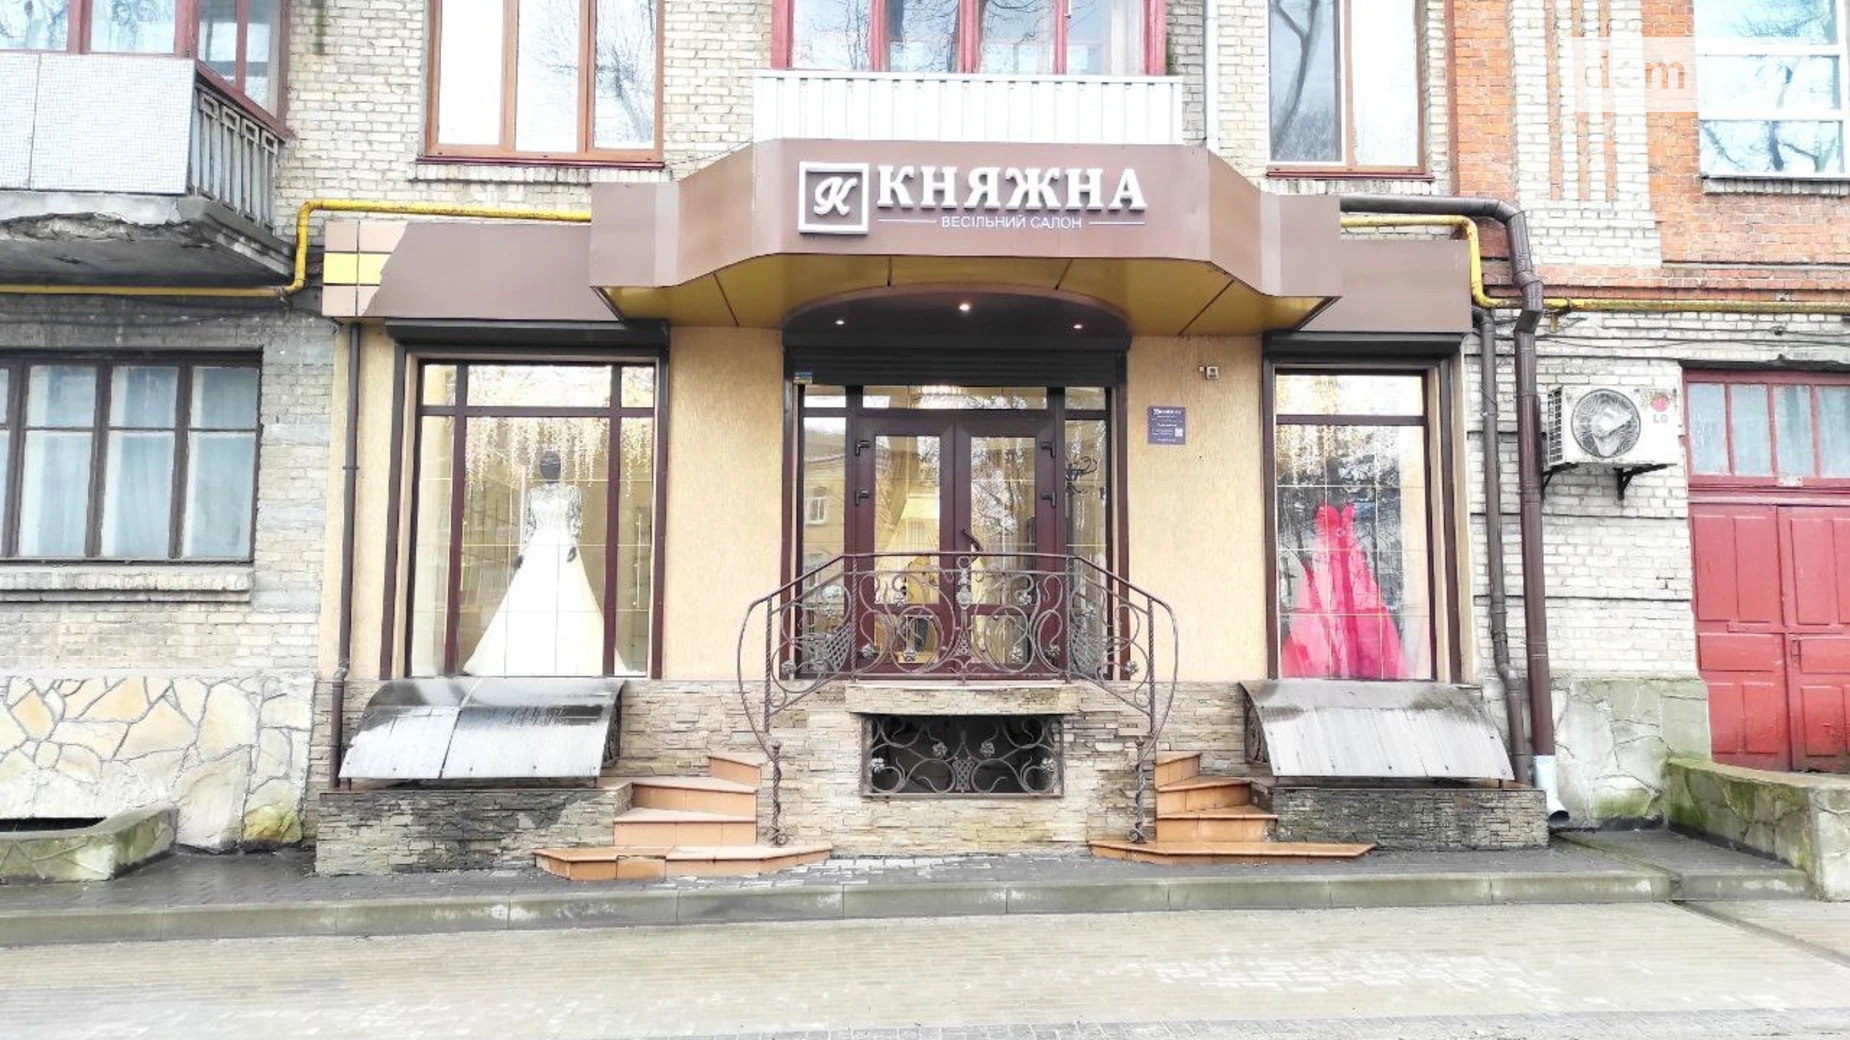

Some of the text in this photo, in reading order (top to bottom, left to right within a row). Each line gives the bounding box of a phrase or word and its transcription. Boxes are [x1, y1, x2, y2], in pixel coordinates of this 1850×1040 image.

[877, 164, 1147, 211] КНЯЖНА
[941, 215, 1082, 229] ВЕСІЛЬНИЙ САЛОН
